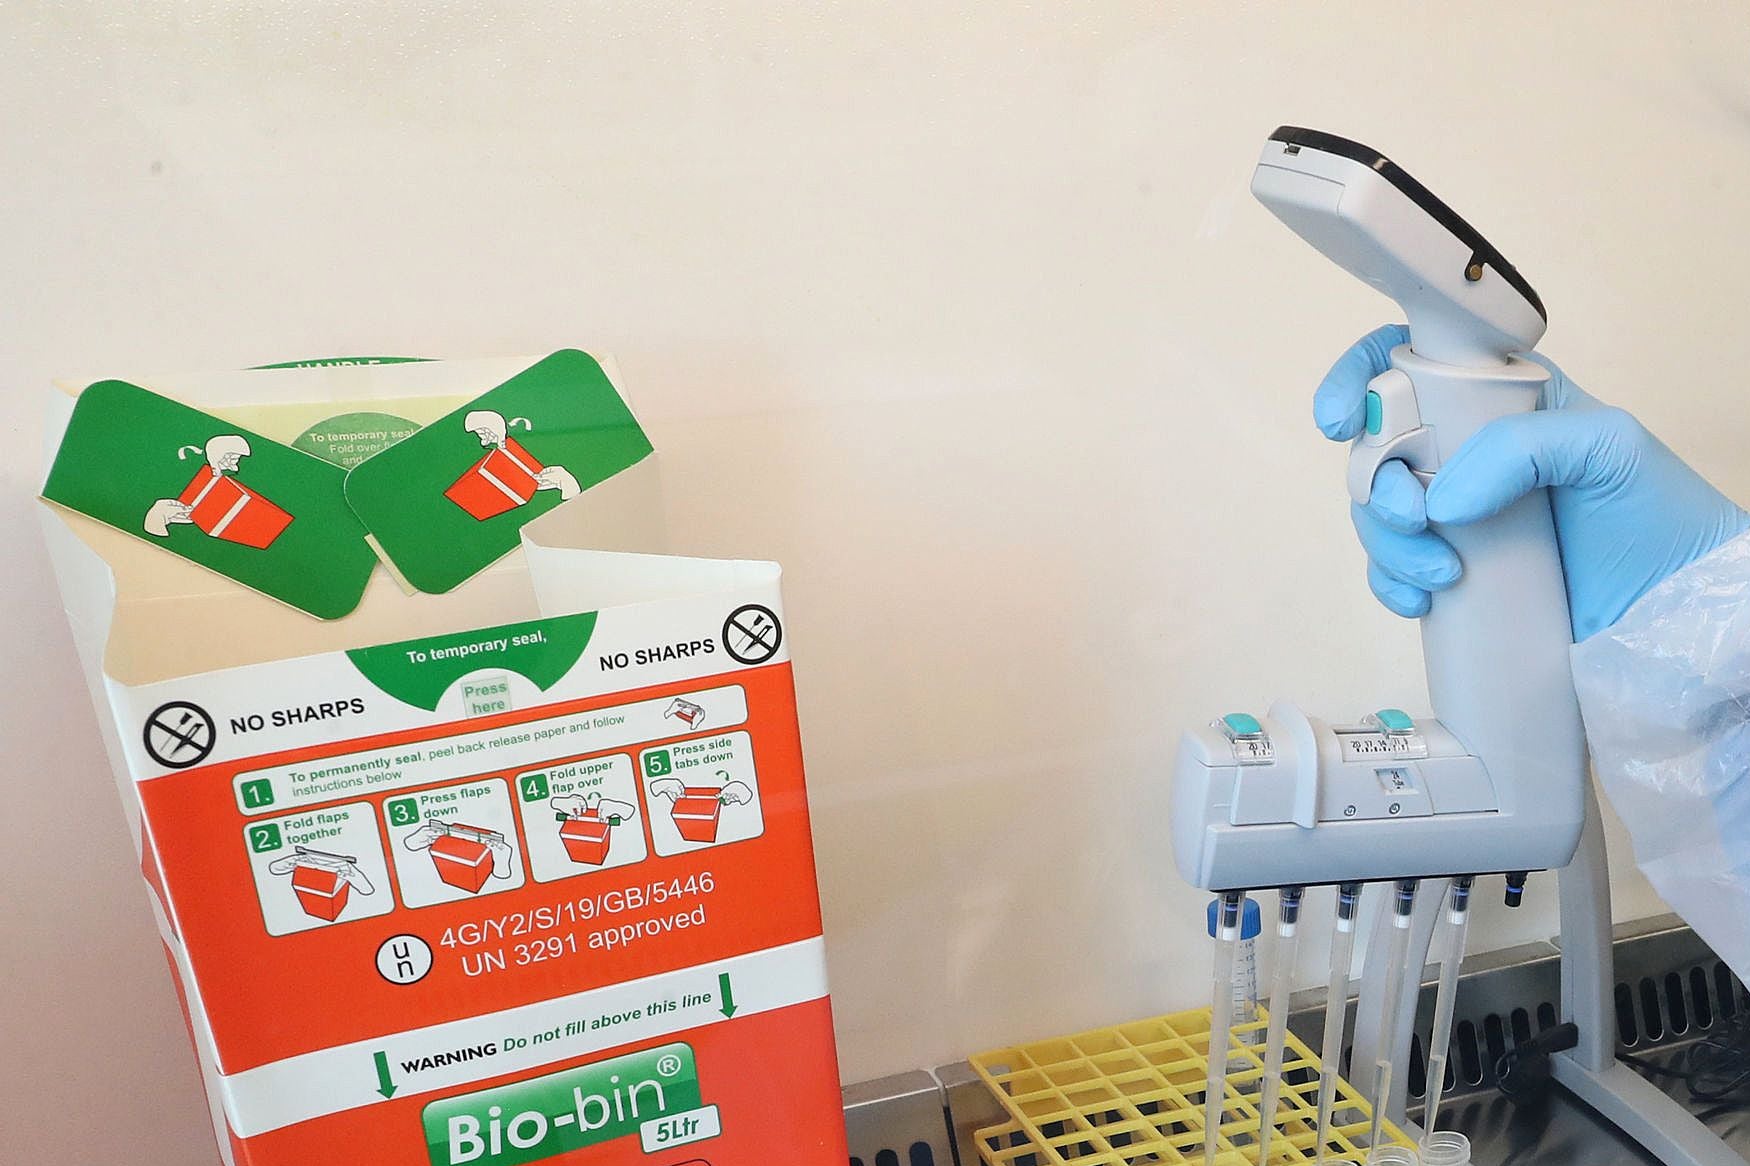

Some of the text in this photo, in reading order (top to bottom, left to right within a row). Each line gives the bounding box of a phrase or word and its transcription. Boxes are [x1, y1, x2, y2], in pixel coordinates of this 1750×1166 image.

[309, 432, 325, 443] To
[328, 429, 388, 443] temporary
[330, 444, 354, 454] Fold
[406, 630, 547, 664] To temporary seal,
[599, 638, 715, 671] NO SHARPS
[464, 682, 507, 699] Press
[230, 698, 365, 735] NO SHARPS
[472, 699, 506, 715] here
[289, 772, 305, 783] To
[310, 757, 391, 782] permanently
[429, 746, 454, 760] peel
[457, 741, 486, 754] back
[489, 732, 531, 748] release
[534, 726, 566, 741] paper
[569, 721, 590, 733] and
[593, 714, 625, 728] follow
[673, 738, 732, 756] Press side
[550, 760, 614, 780] Fold upper
[650, 756, 669, 773] 5.
[675, 751, 734, 770] tabs down
[292, 770, 403, 797] instructions below
[525, 780, 547, 797] 4.
[552, 776, 605, 795] flap over
[249, 785, 271, 804] 1.
[420, 784, 491, 805] Press flaps
[284, 811, 350, 830] Fold flaps
[394, 804, 416, 822] 3.
[424, 805, 459, 819] down
[255, 830, 278, 850] 2.
[287, 826, 343, 846] together
[440, 871, 715, 949] 4G/Y2/S/19/GB/5446
[461, 904, 706, 977] UN 3291 approved
[400, 992, 712, 1075] WARNING Do not fill above this line
[655, 1116, 700, 1143] 5Ltr
